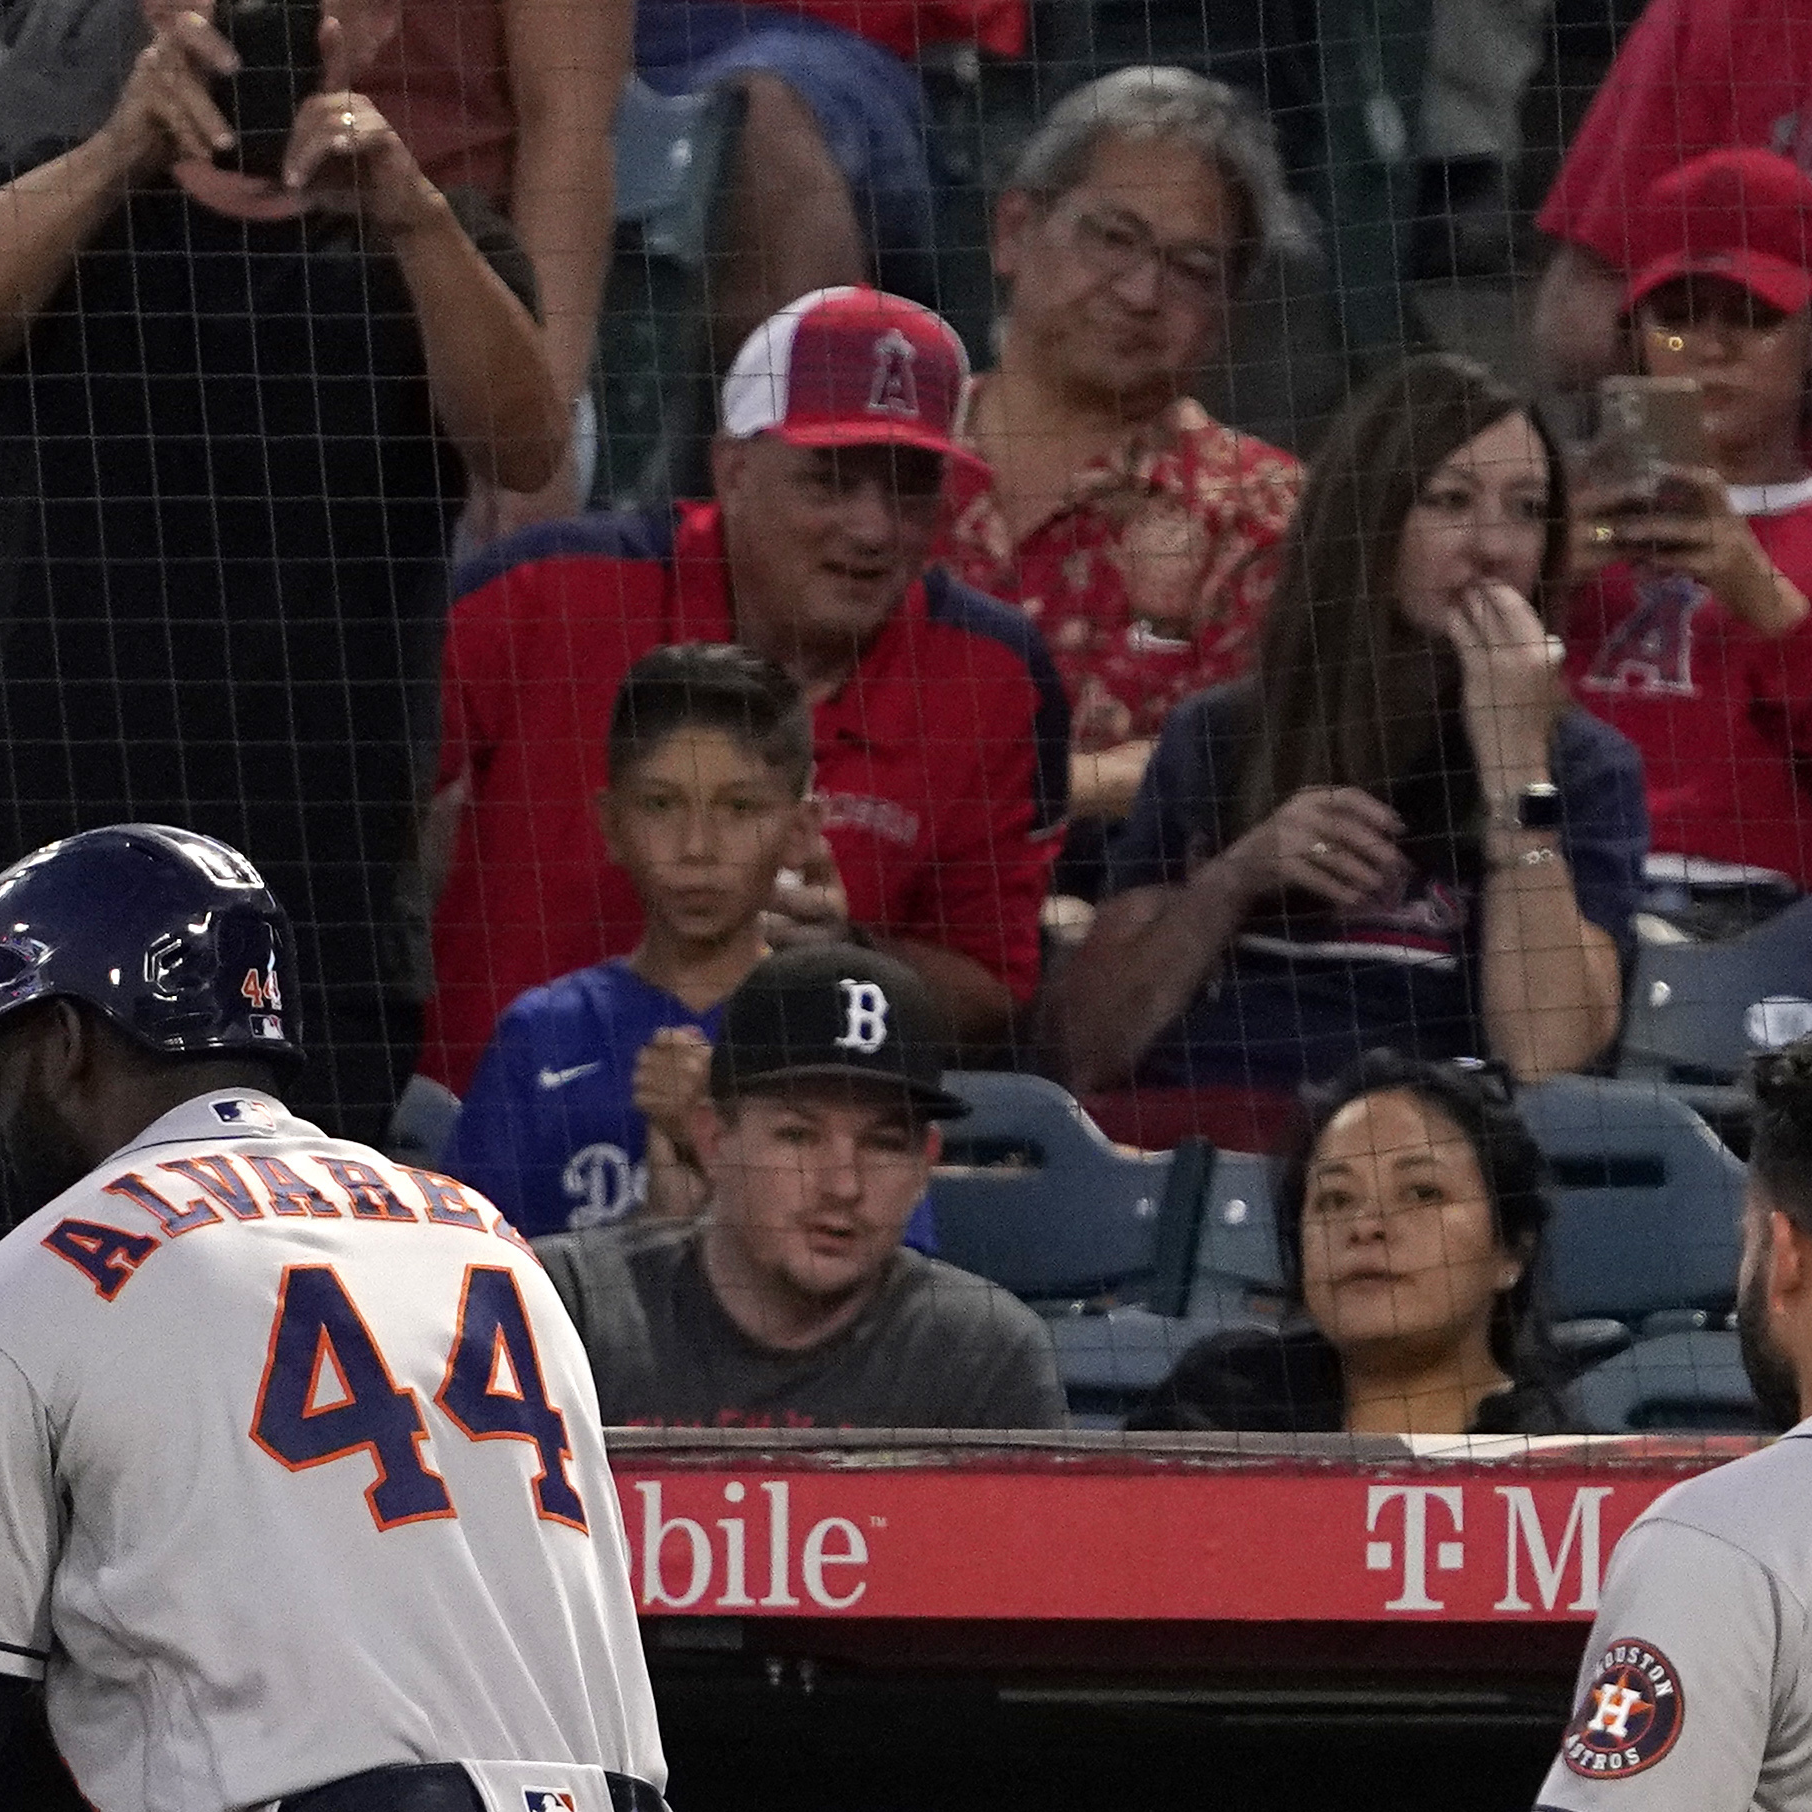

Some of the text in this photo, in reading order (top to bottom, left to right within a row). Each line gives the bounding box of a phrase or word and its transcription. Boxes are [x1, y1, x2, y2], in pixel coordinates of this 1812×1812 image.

[241, 968, 283, 1011] 44
[834, 978, 891, 1054] B
[249, 1263, 589, 1537] 44
[625, 1480, 870, 1609] bile
